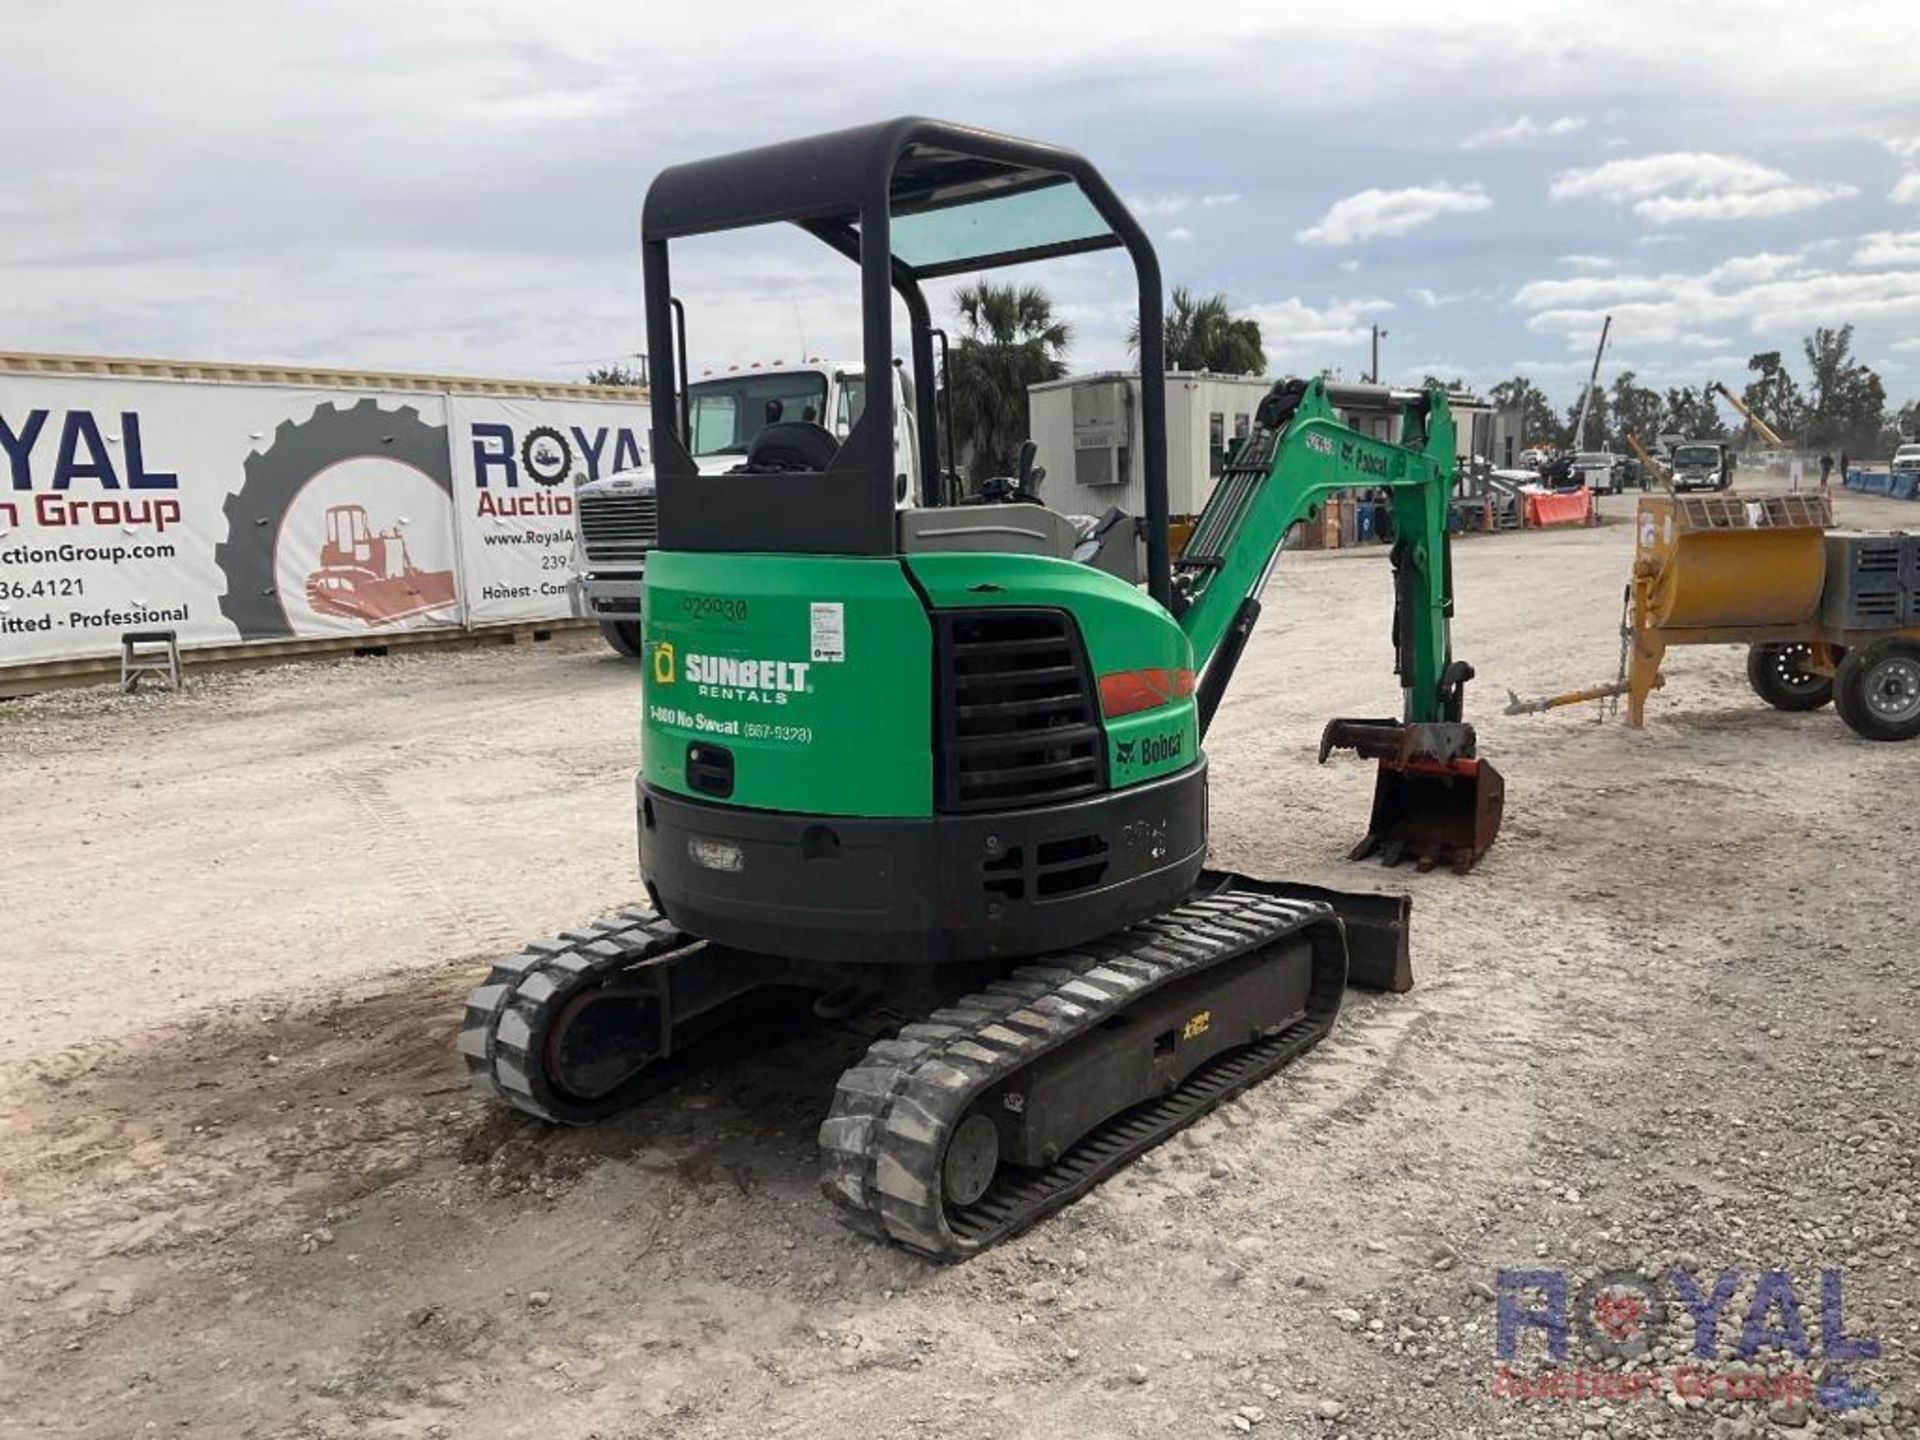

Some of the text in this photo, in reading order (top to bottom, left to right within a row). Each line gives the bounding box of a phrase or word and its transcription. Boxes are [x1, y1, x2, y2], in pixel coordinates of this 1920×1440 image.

[35, 494, 181, 532] Group
[483, 584, 531, 600] Honest
[70, 604, 189, 629] Professional
[686, 654, 810, 692] SUNBELT
[699, 686, 788, 705] RENTALS
[677, 710, 693, 729] No
[695, 713, 739, 736] Sweat
[1141, 730, 1184, 766] Bobcat
